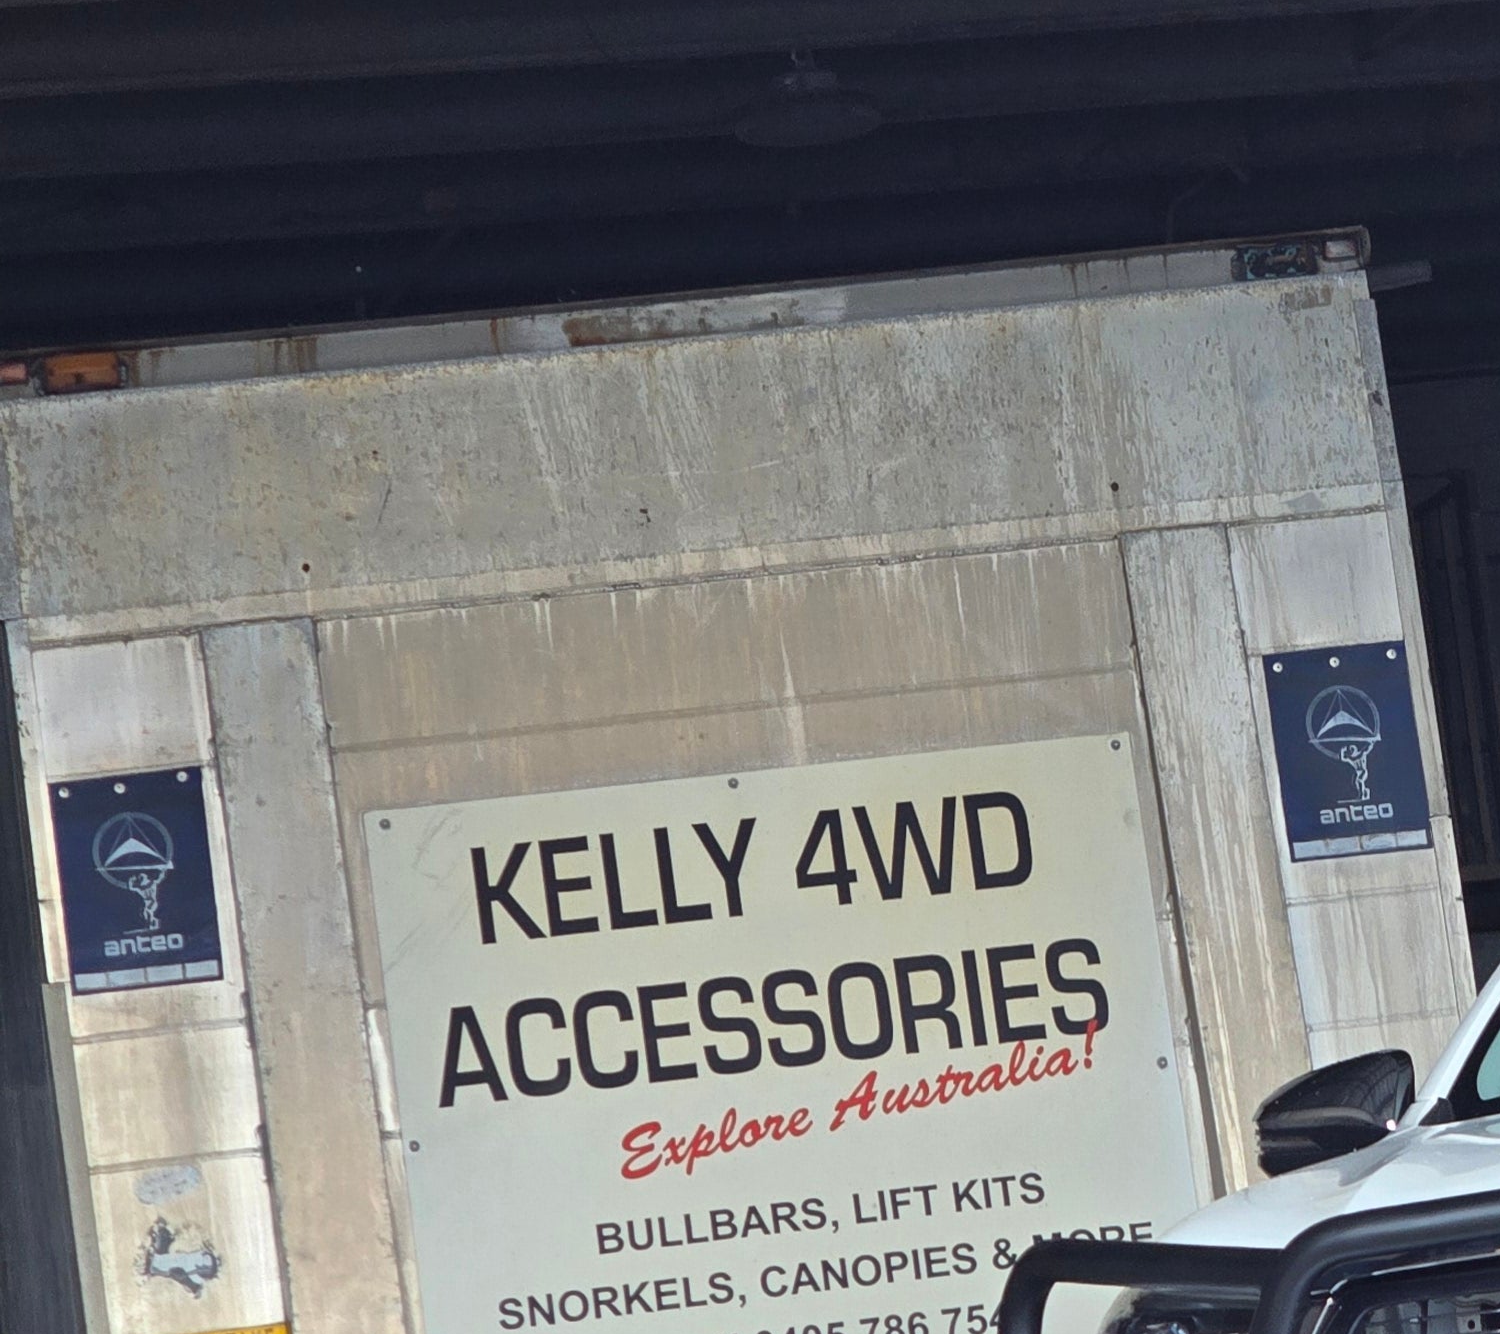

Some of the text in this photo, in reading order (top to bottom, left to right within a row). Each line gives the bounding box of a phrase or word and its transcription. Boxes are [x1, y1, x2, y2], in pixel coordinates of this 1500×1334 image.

[1319, 802, 1394, 825] anteo
[469, 791, 1034, 944] KELLY 4WD
[103, 933, 184, 957] anteo
[438, 938, 1110, 1108] ACCESSORIES
[620, 1019, 1098, 1180] Explore Australia!
[595, 1172, 1046, 1255] BULLBARS, LIFT KITS
[498, 1238, 1017, 1330] SNORKELS, CANOPIES &
